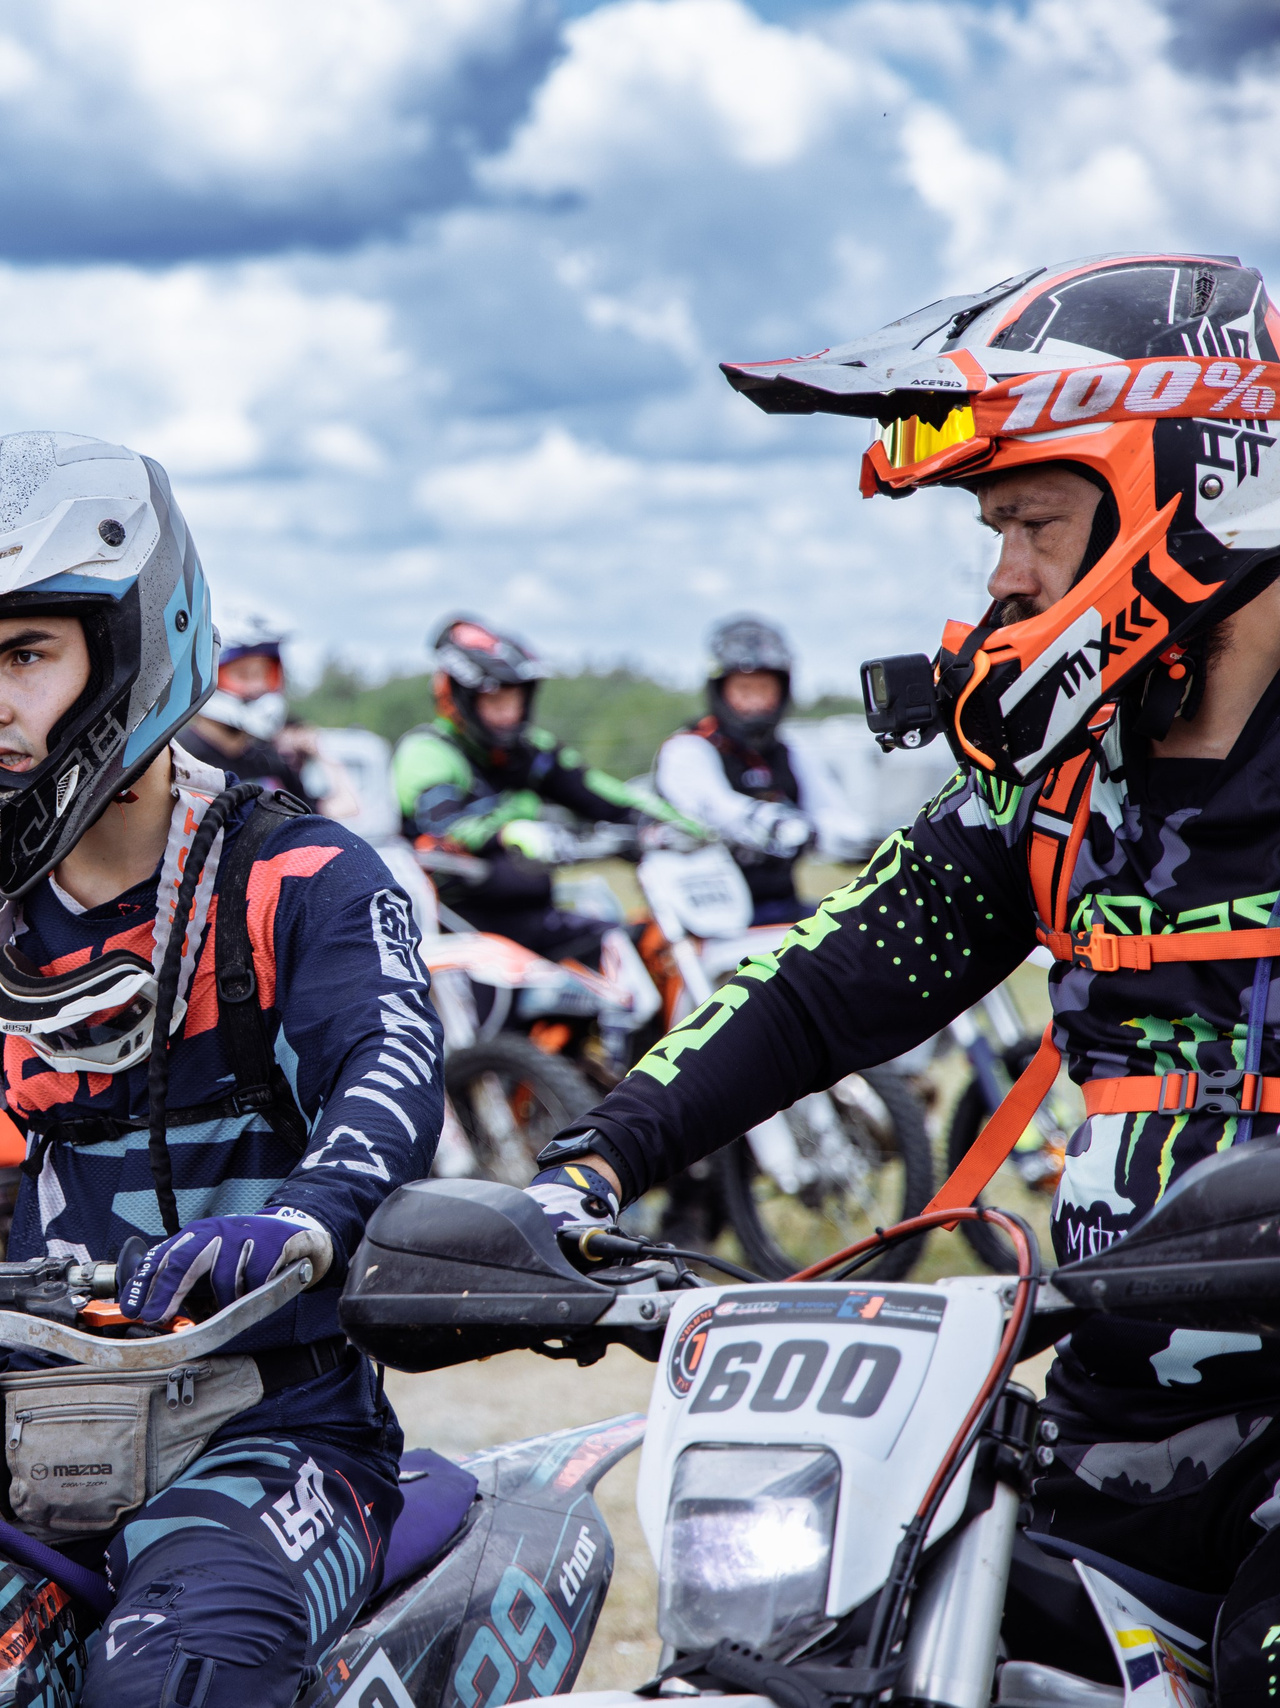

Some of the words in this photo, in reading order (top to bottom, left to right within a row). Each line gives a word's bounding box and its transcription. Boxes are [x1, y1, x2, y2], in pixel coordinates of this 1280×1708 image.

[1001, 361, 1276, 432] 100%
[127, 1279, 143, 1307] RIDE
[689, 1339, 902, 1418] 600
[53, 1464, 113, 1477] mazda
[559, 1524, 598, 1608] thor
